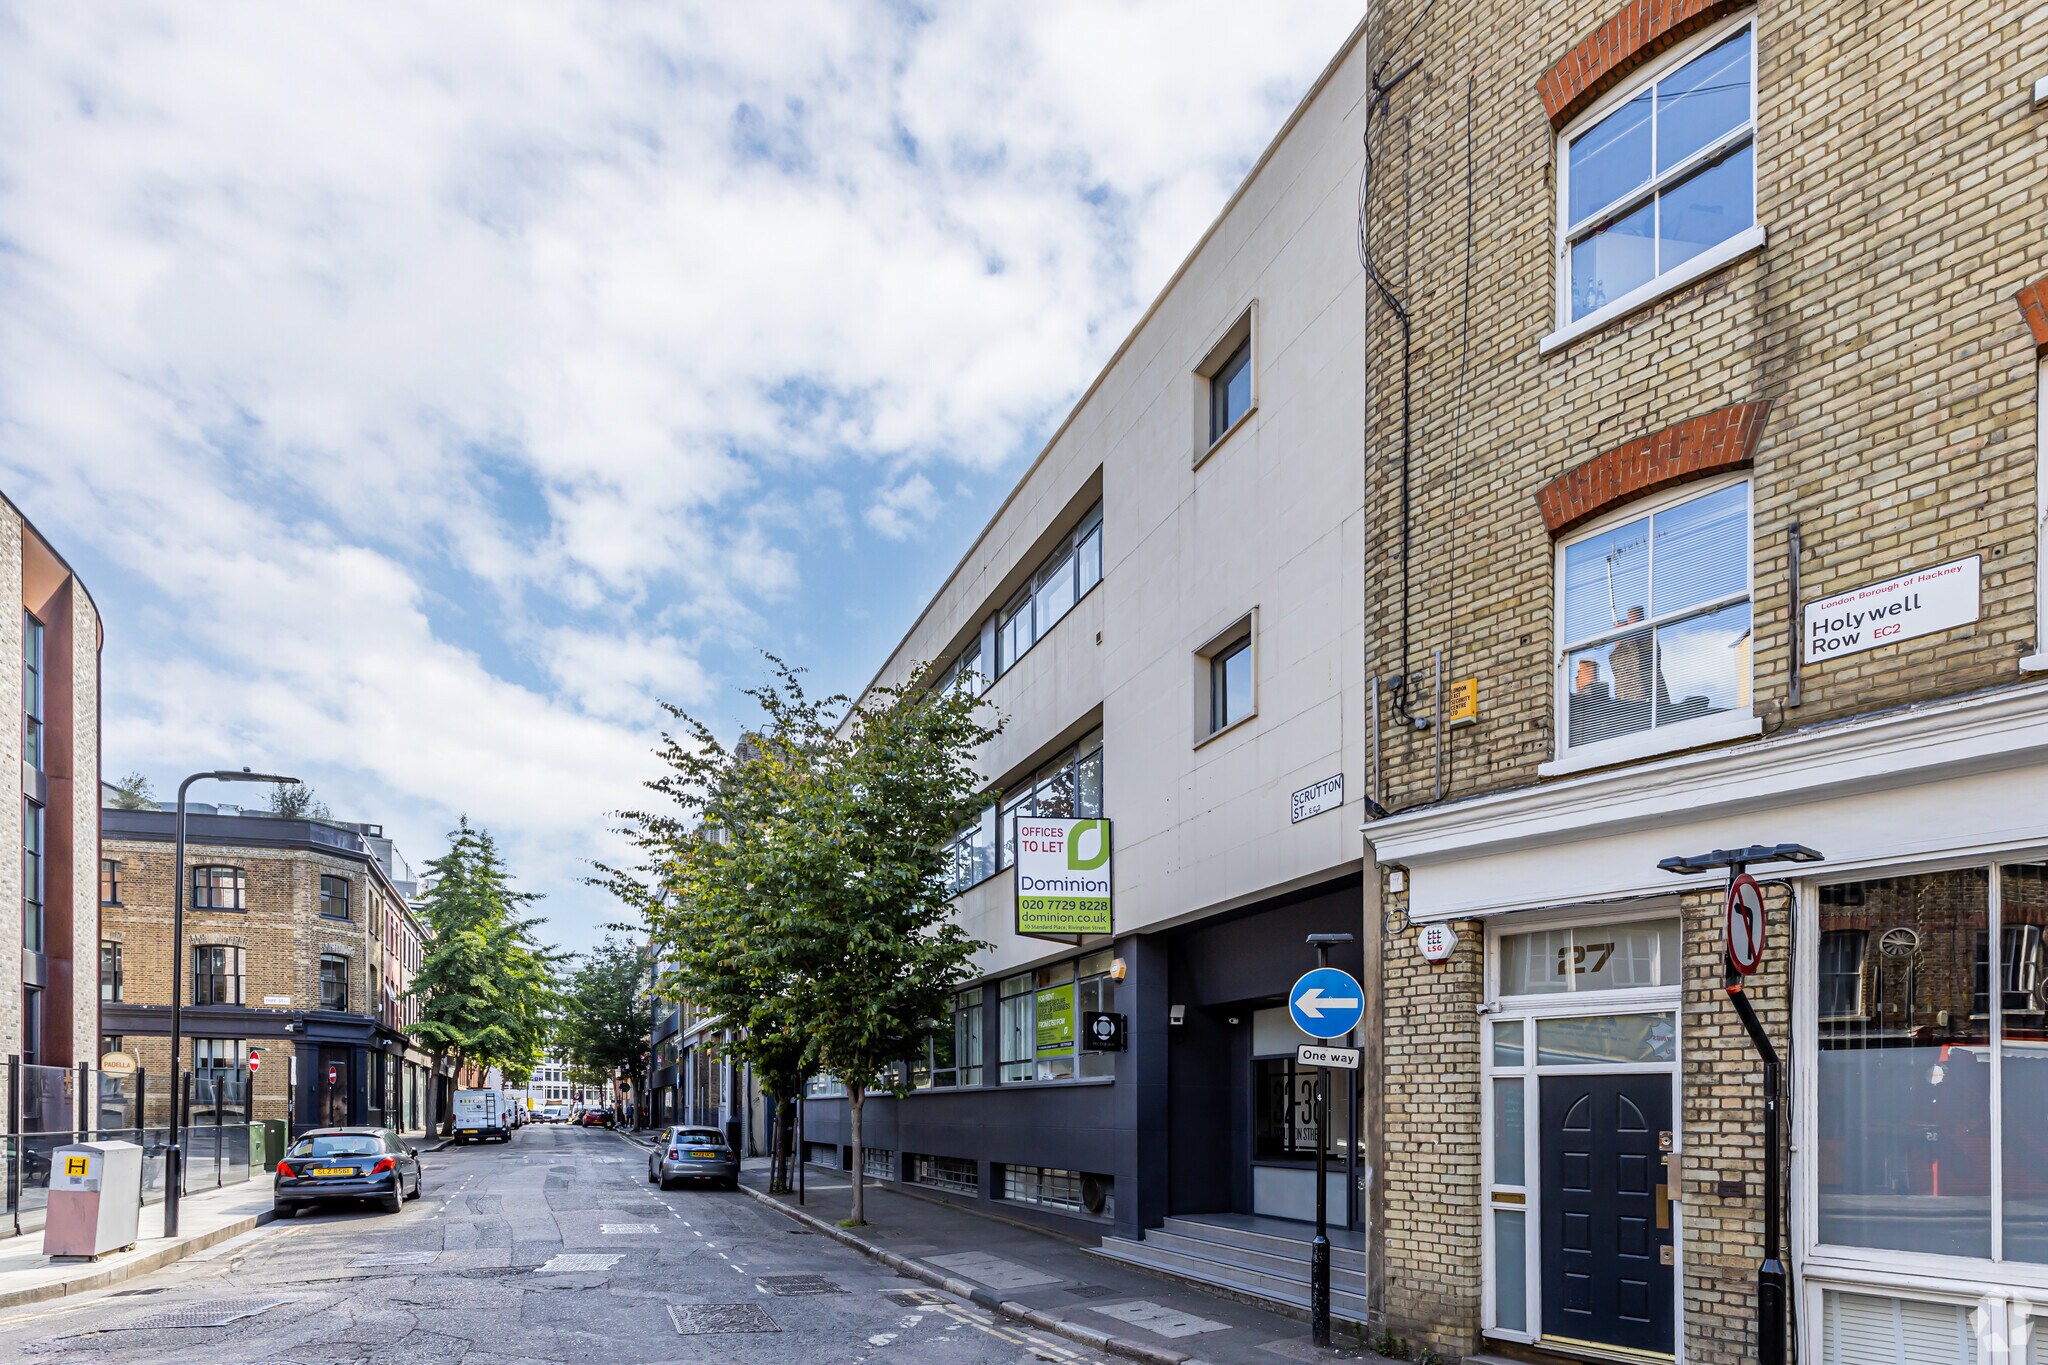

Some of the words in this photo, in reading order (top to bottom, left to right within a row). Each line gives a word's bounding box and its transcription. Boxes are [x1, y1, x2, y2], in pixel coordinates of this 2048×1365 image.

[1821, 595, 1855, 610] London
[1858, 582, 1899, 599] Borough
[1903, 577, 1914, 587] of
[1917, 565, 1963, 583] Hackney
[1812, 593, 1921, 637] Holywell
[1812, 632, 1861, 655] Row
[1873, 623, 1901, 639] EC2
[1294, 777, 1341, 807] SCRUTTON
[1294, 805, 1307, 820] ST.
[1022, 827, 1064, 837] OFFICES
[1022, 840, 1038, 852] TO
[1042, 841, 1064, 853] LET
[1021, 876, 1108, 892] Dominion
[1022, 899, 1044, 910] 020
[1047, 900, 1076, 911] 7729
[1079, 901, 1108, 911] 8228
[1021, 911, 1107, 923] dominion.co.uk
[1427, 944, 1443, 952] LSG
[1557, 942, 1615, 976] 27
[104, 1061, 131, 1069] PADELLA
[1303, 1050, 1327, 1060] One
[1330, 1054, 1355, 1065] way
[1767, 1100, 1774, 1110] 1
[68, 1158, 86, 1174] H
